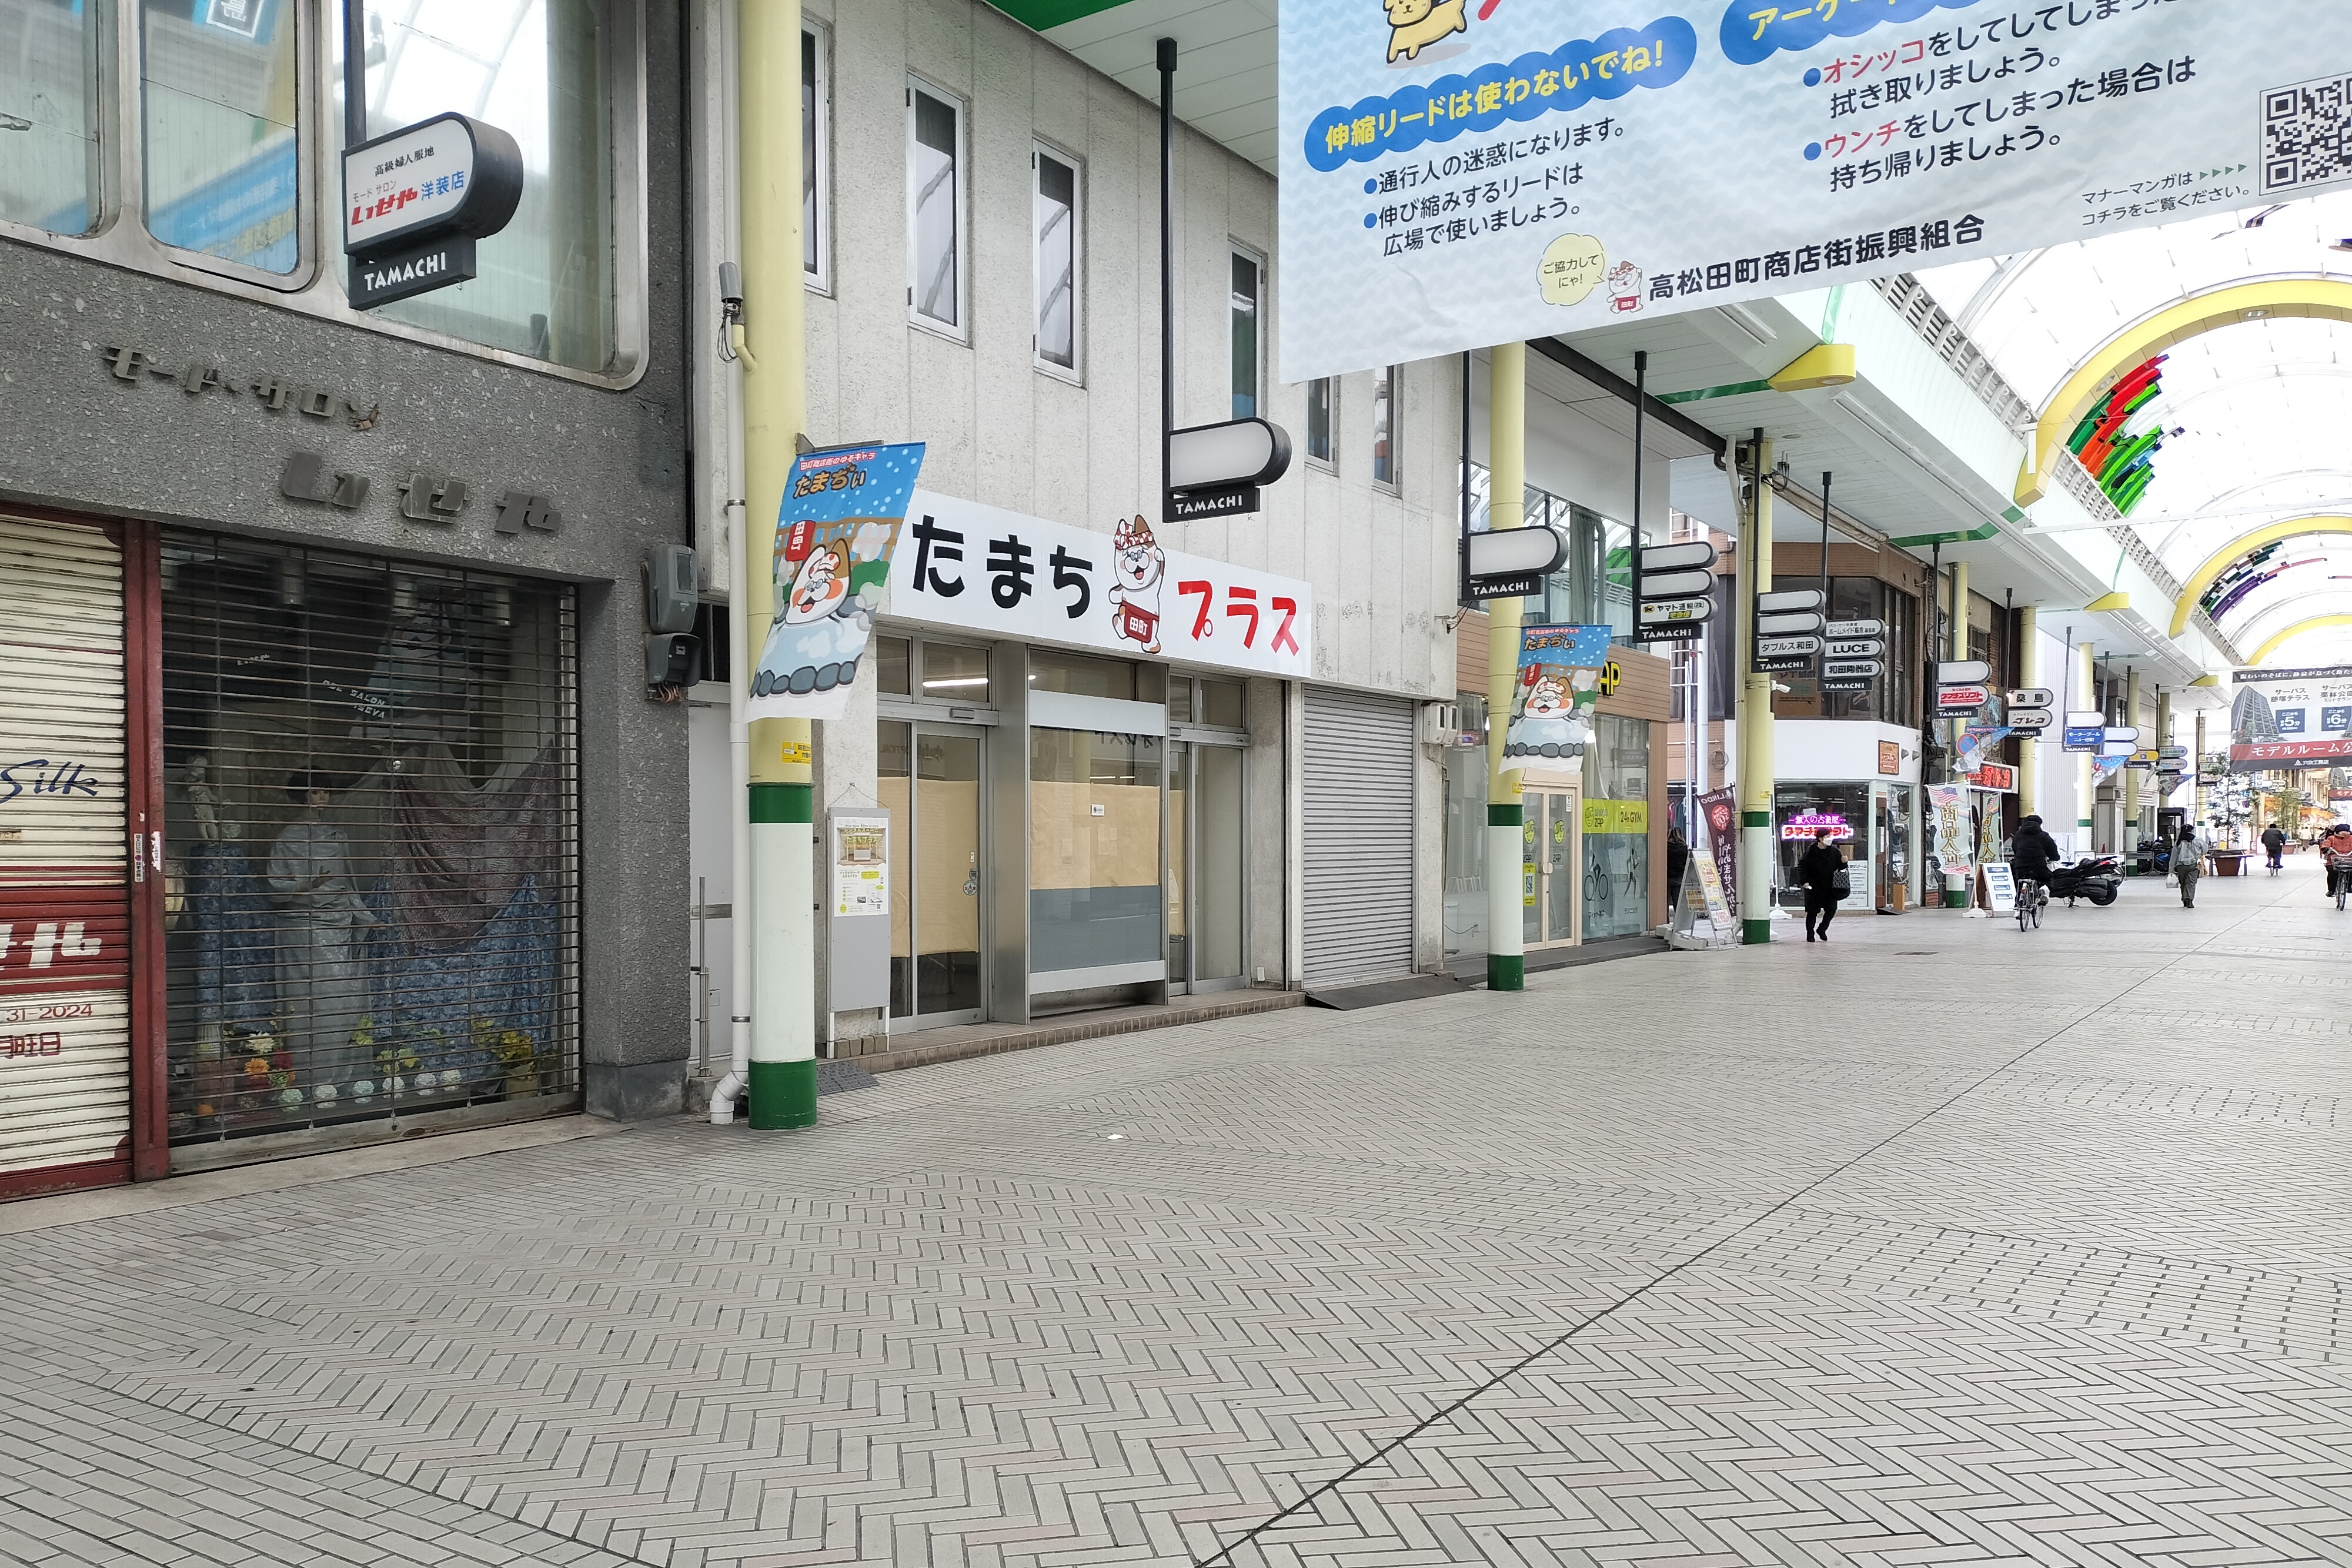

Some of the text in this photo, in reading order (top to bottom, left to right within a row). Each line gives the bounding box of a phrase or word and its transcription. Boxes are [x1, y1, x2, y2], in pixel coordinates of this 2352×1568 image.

[1830, 47, 2060, 119] 拭き取りましょう。
[1825, 55, 2196, 158] ウンチをしてしまった場合は
[375, 145, 435, 176] 高級婦人服地
[1379, 116, 1623, 195] 通行人の迷惑になります。
[1830, 125, 2060, 192] 持ち帰りましょう。
[351, 170, 464, 225] いせや 洋装店
[1379, 163, 1583, 229] 伸び縮みするリードは
[2082, 170, 2194, 205] マナーマンガは
[2082, 185, 2250, 226] コチラをご覧ください。
[1383, 196, 1580, 257] 広場で使いましょう。
[365, 252, 446, 291] TAMACHI
[1544, 255, 1599, 274] ご協力して
[1648, 213, 1984, 302] 高松田町商店街振興組合
[800, 451, 877, 471] 田町商店街のゆるキャラ
[281, 450, 562, 534] いせや
[793, 463, 867, 499] たまぢい
[1176, 494, 1242, 515] TAMACHI
[791, 520, 806, 551] 田町
[911, 513, 1299, 657] たまち プラス
[1473, 581, 1529, 596] TAMACHI
[1130, 616, 1148, 636] 田町
[1524, 633, 1576, 651] たまぢい
[1642, 628, 1692, 639] TAMACHI
[1759, 661, 1803, 670] TAMACHI
[1833, 643, 1870, 654] LUCE
[0, 759, 98, 804] Silk
[1630, 811, 1642, 823] GYM
